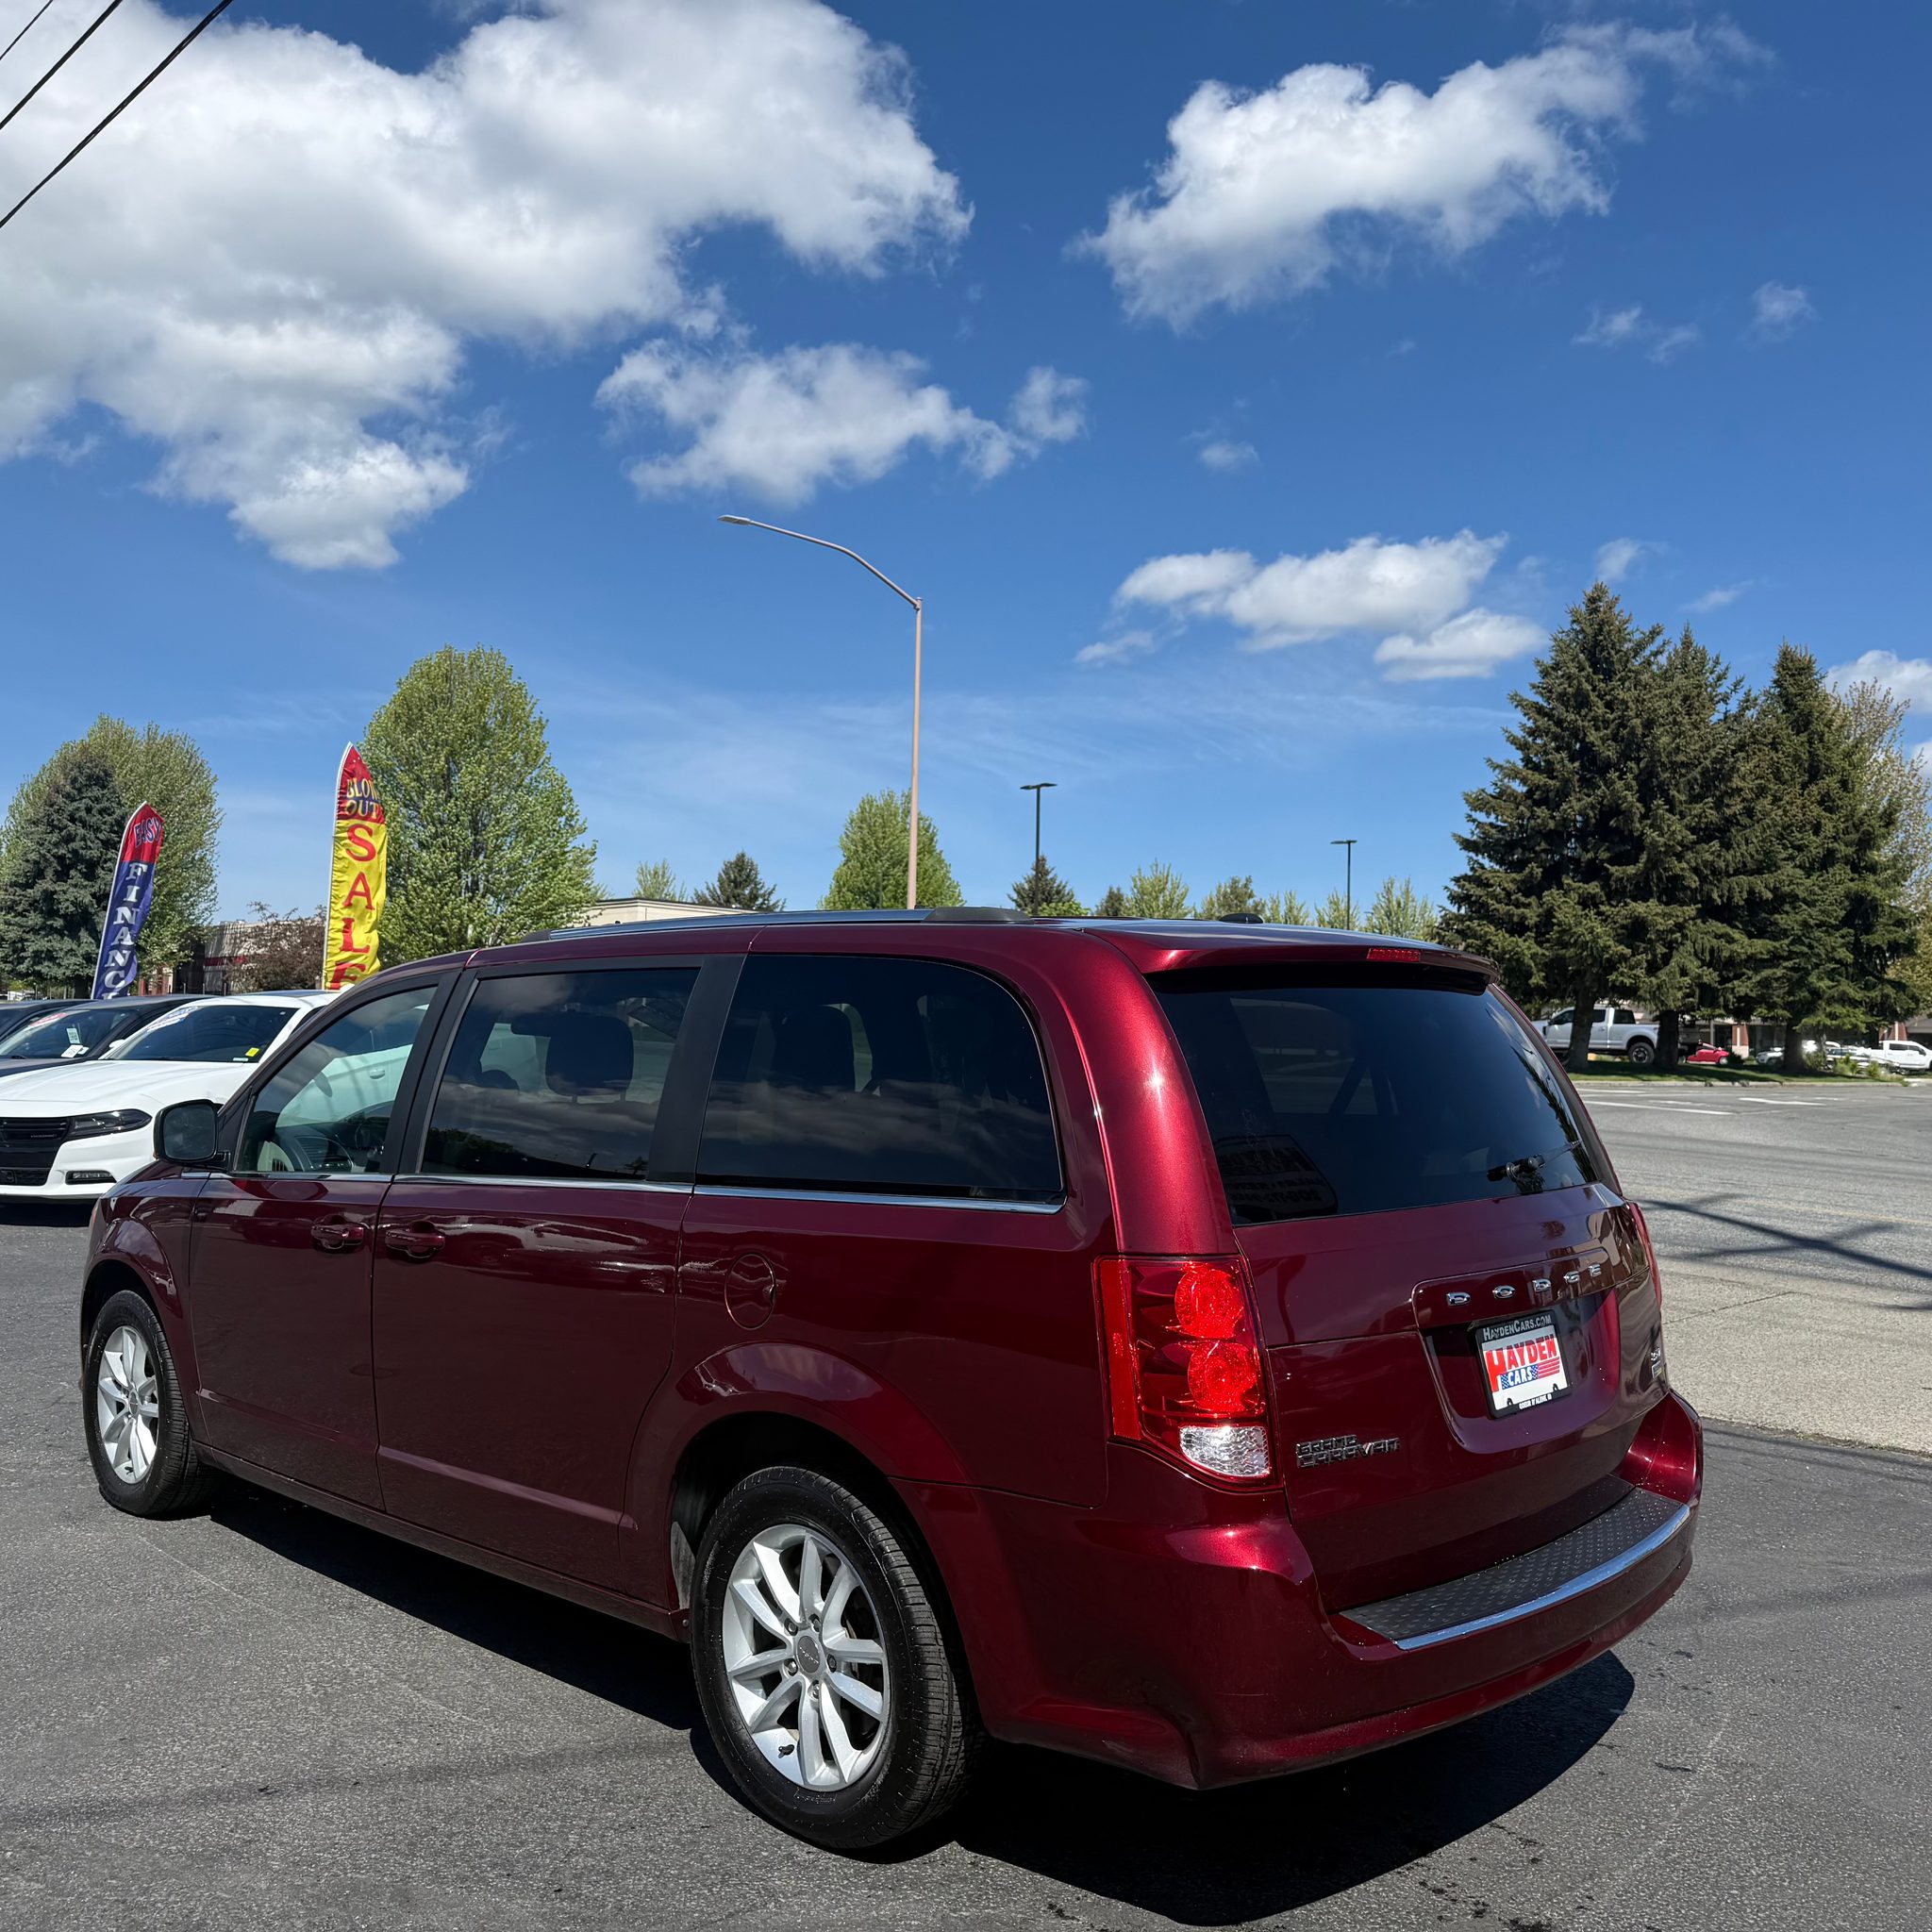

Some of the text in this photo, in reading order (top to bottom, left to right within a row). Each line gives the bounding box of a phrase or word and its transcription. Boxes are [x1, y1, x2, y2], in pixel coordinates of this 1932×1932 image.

[344, 799, 378, 820] OUT
[134, 817, 161, 847] EASY
[102, 862, 148, 1000] FINANC
[1446, 1263, 1602, 1307] DODGE
[1485, 1334, 1557, 1392] HAYDEN
[1507, 1368, 1532, 1387] CARS
